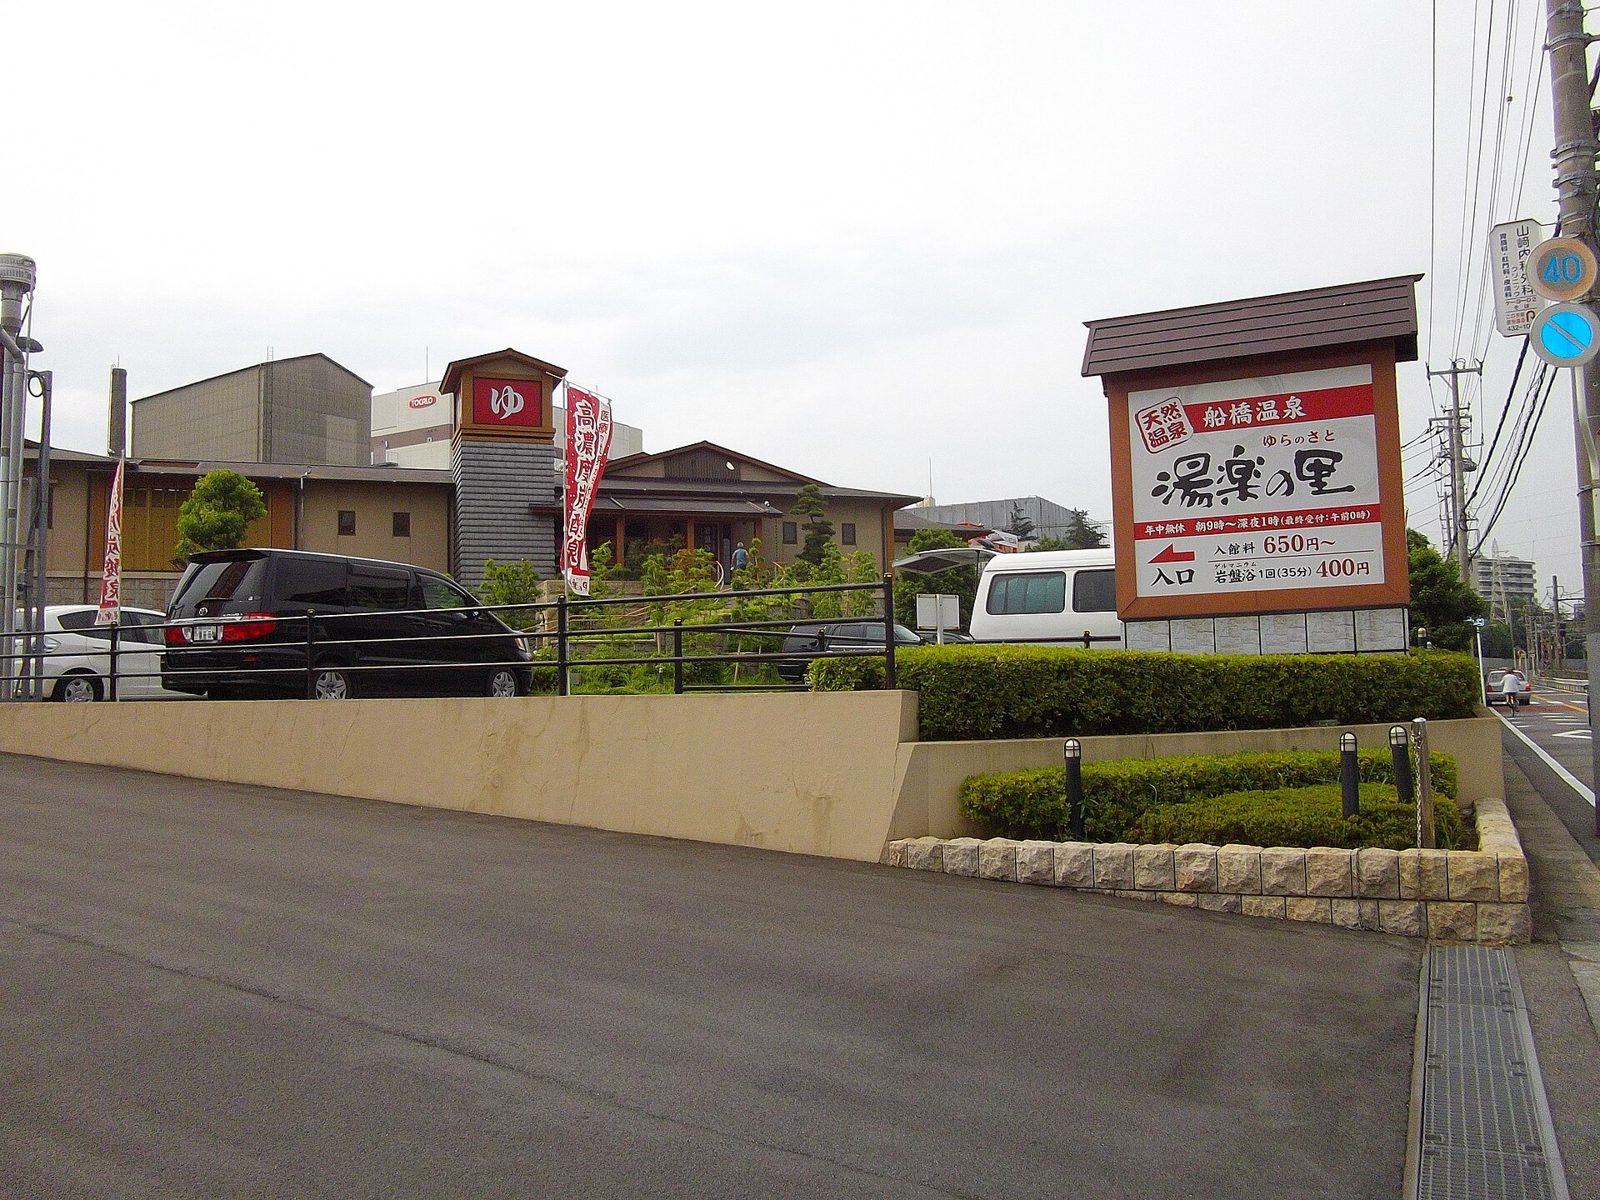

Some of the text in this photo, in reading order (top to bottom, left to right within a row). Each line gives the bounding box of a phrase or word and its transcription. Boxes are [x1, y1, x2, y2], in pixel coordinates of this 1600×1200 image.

[1542, 255, 1582, 283] 40
[491, 385, 525, 420] ゆ
[1202, 396, 1307, 428] 船橋温泉
[1141, 402, 1183, 431] 天然
[1147, 421, 1188, 448] 温泉
[1262, 429, 1337, 448] ゆらのさと
[1151, 445, 1355, 509] 湯楽の里
[1144, 523, 1186, 535] 年中無休
[1214, 542, 1256, 556] 入館料
[1151, 568, 1195, 586] 入口
